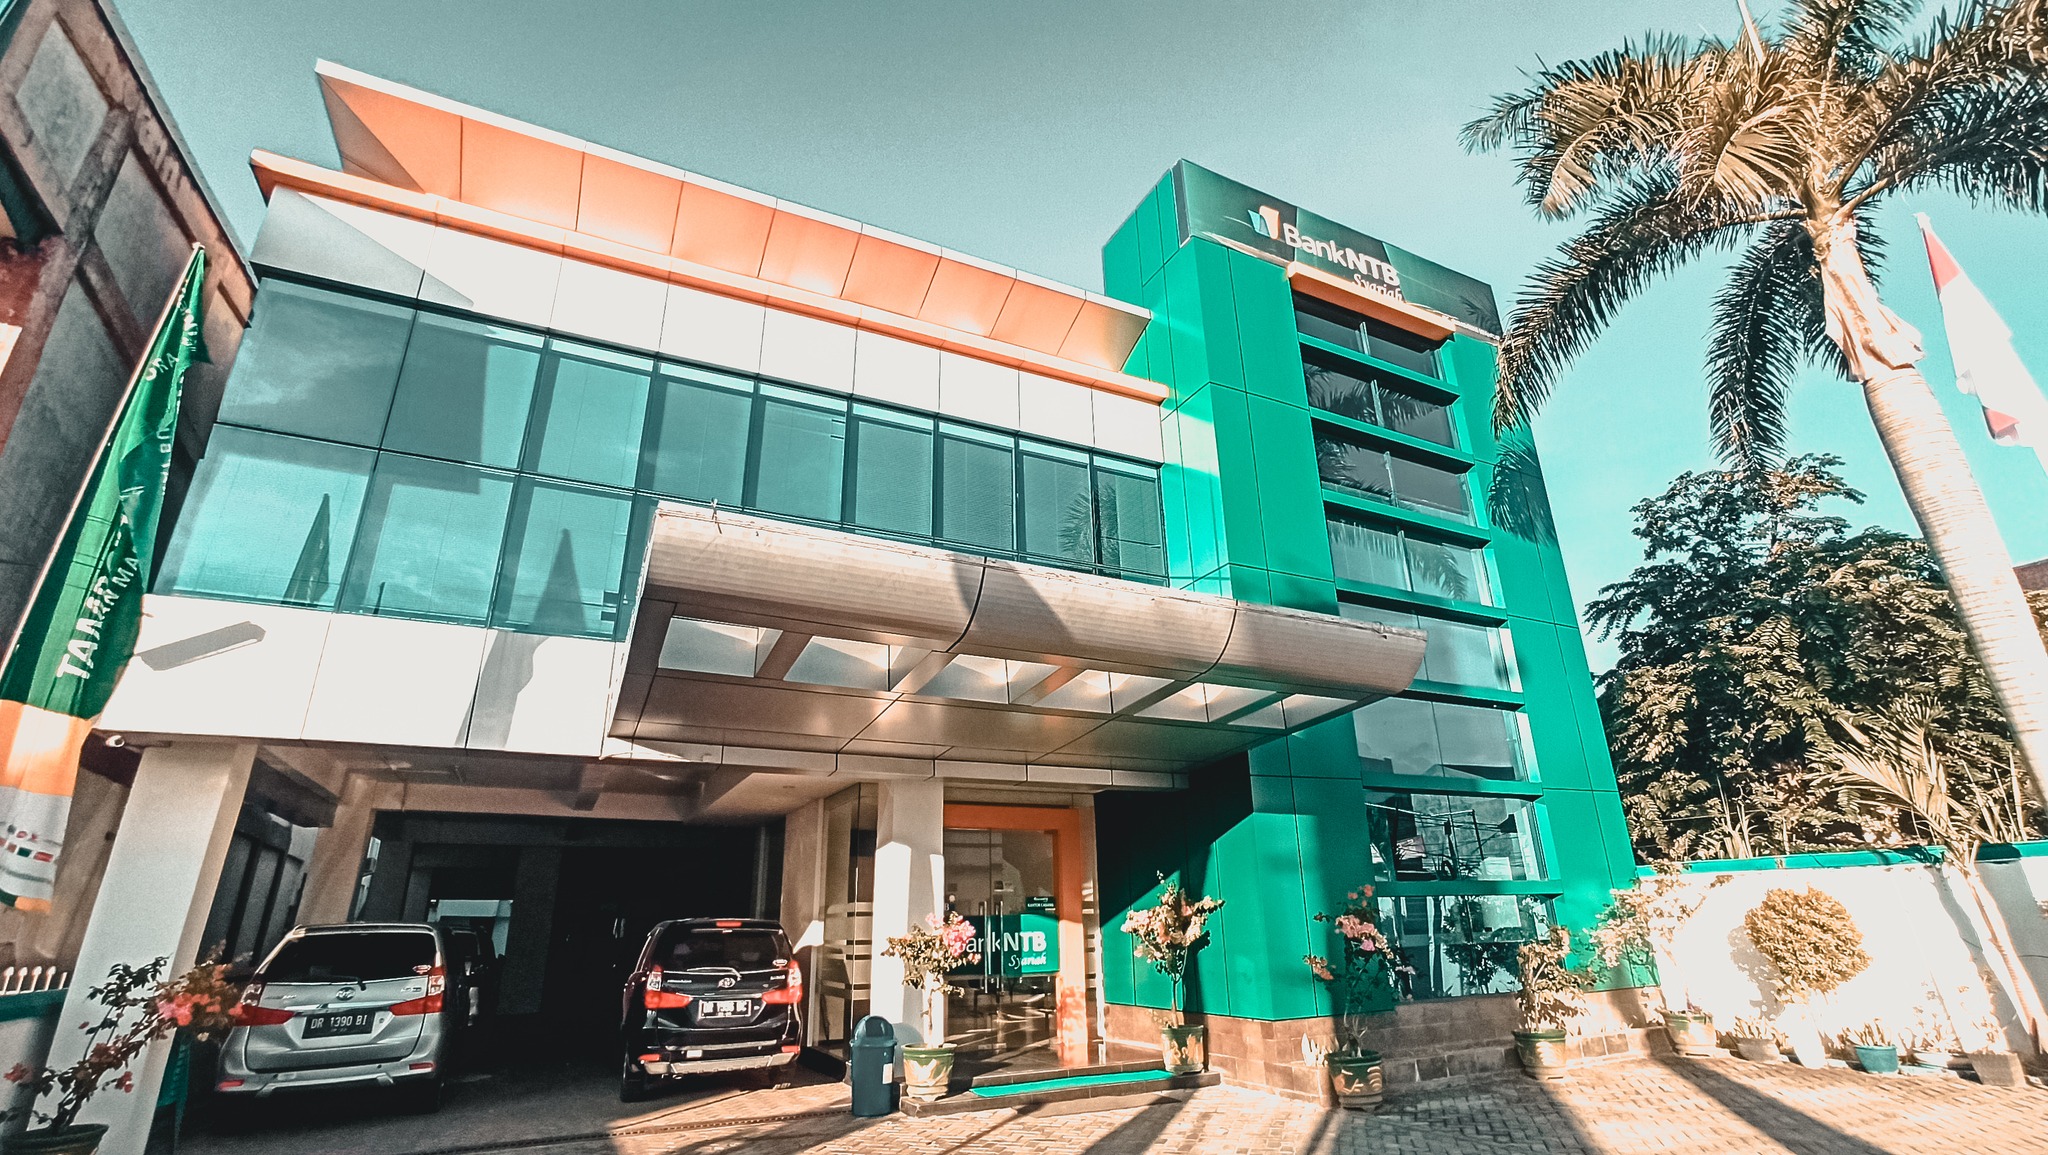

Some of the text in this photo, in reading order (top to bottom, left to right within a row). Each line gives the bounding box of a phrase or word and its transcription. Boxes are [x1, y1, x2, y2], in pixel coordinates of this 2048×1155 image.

[1283, 223, 1400, 286] BankNTB
[1353, 273, 1403, 302] Syariah
[961, 931, 1047, 952] ankNTB
[1008, 952, 1047, 970] Syariah
[311, 1017, 324, 1029] DR
[330, 1015, 353, 1027] 1390
